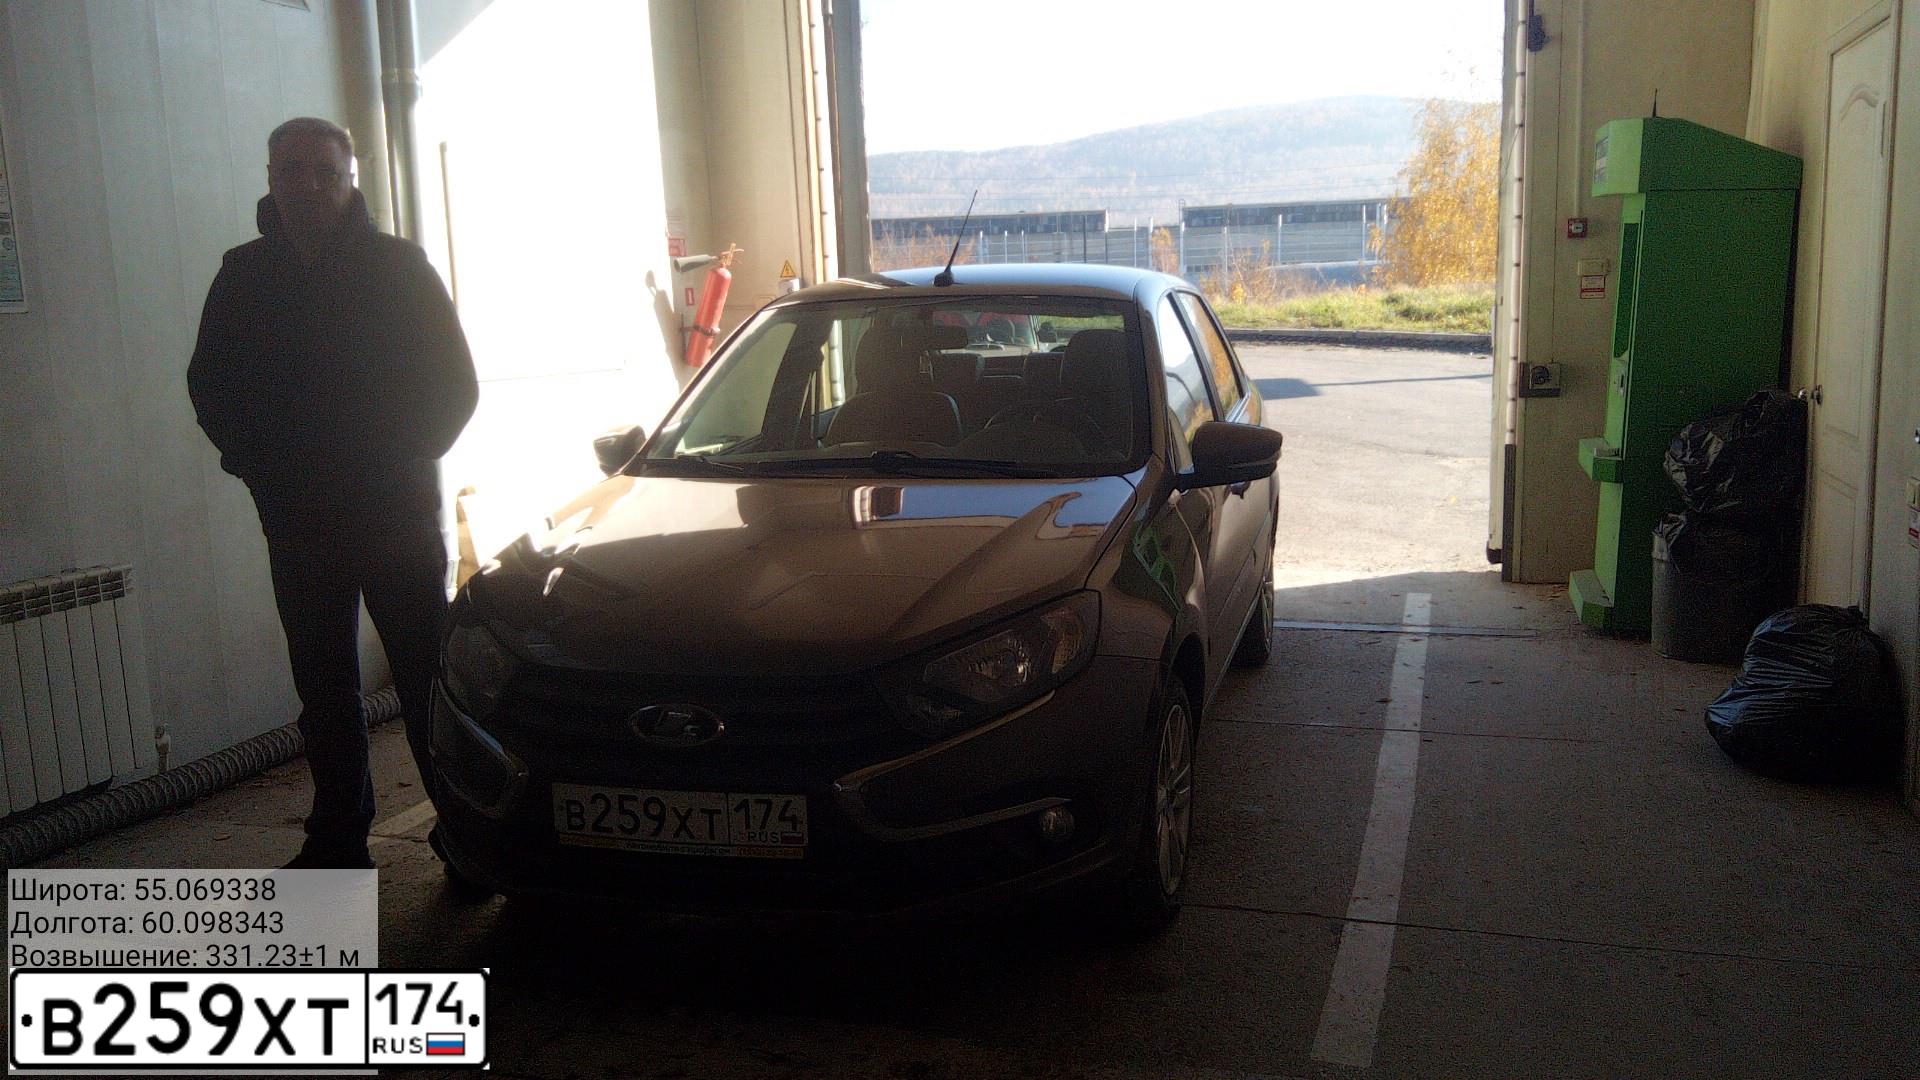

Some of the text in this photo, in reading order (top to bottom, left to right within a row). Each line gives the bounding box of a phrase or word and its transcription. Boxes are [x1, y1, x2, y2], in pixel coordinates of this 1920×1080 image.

[566, 792, 798, 841] В259ХТ 174
[748, 831, 780, 844] RUS
